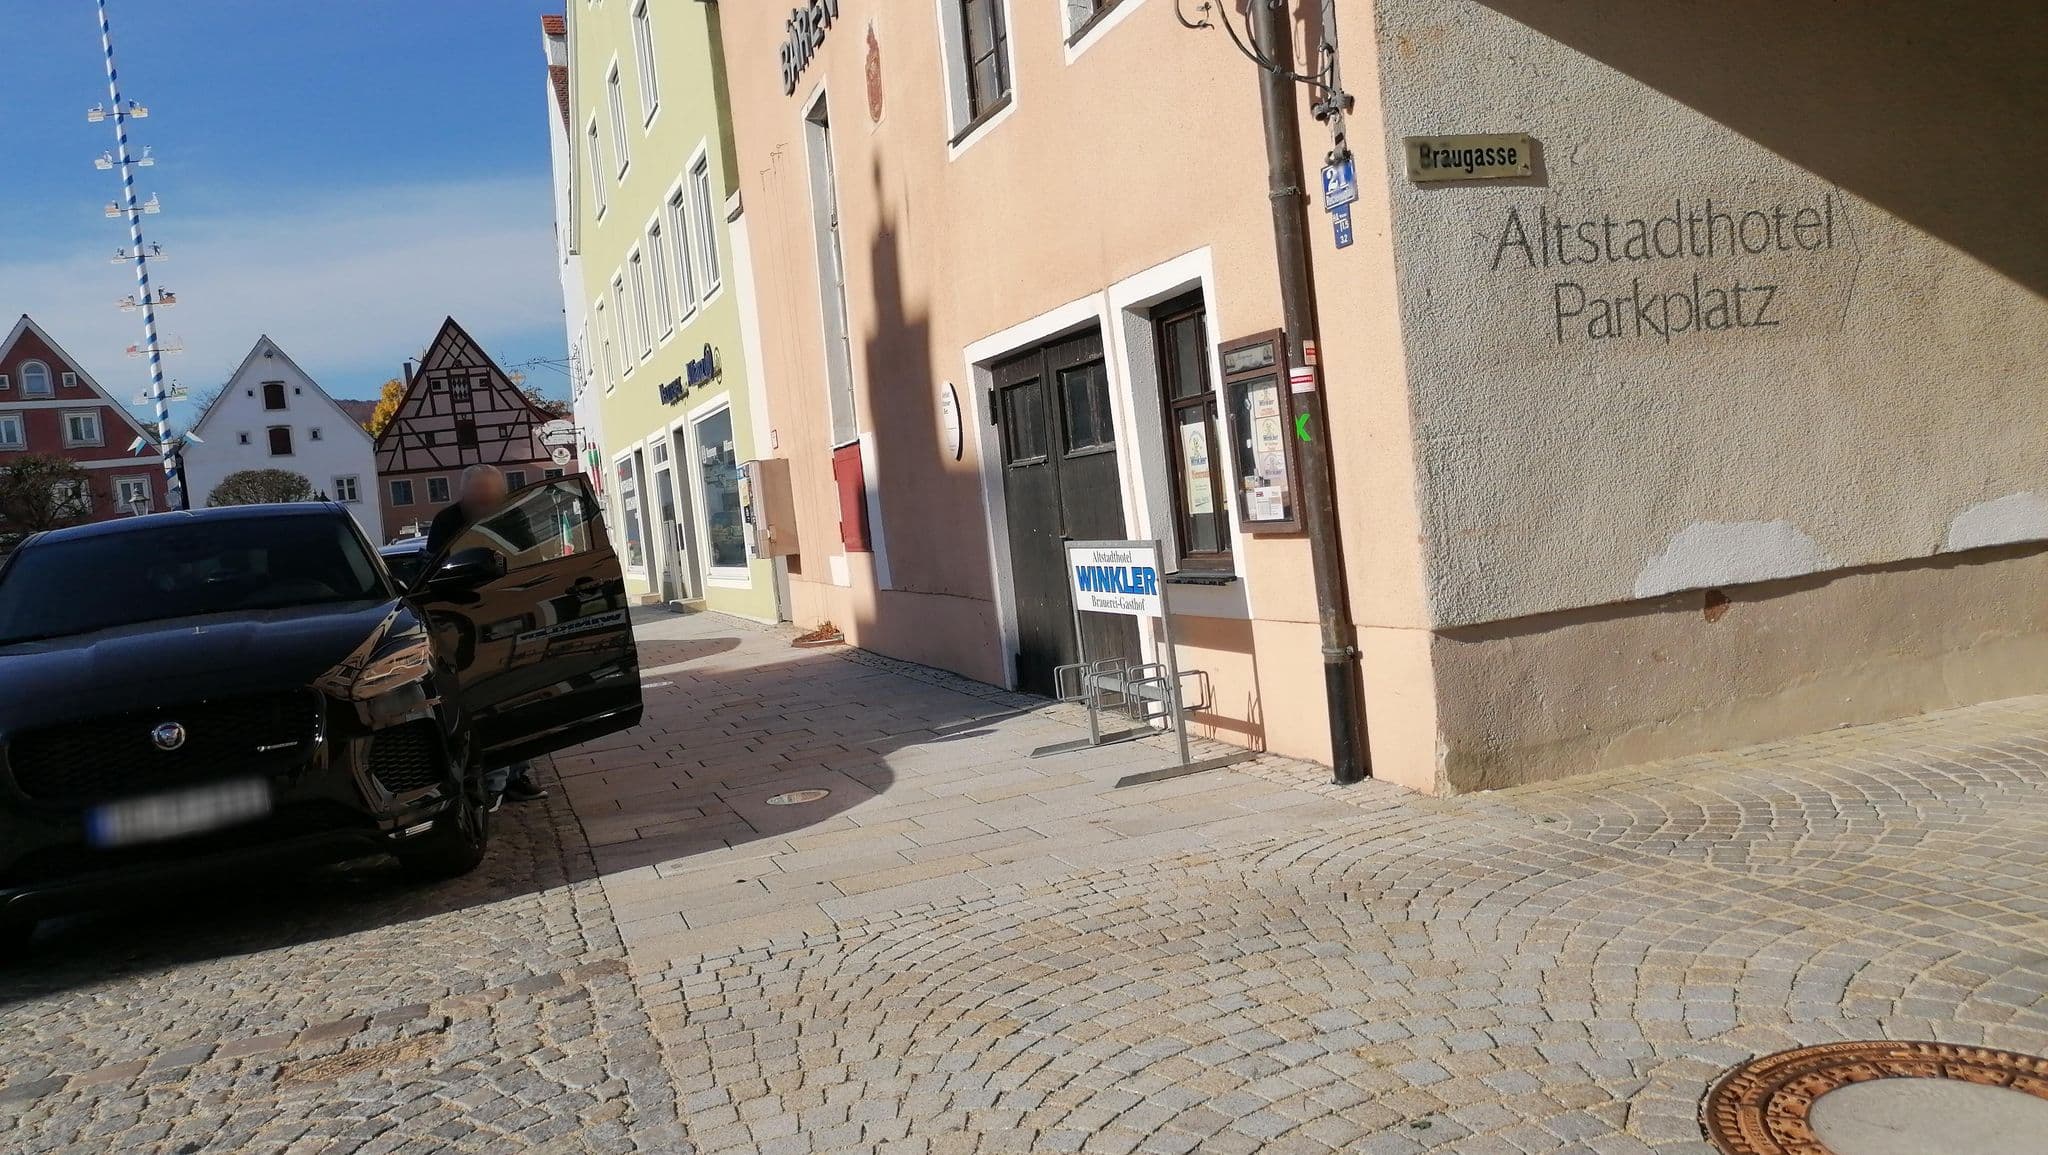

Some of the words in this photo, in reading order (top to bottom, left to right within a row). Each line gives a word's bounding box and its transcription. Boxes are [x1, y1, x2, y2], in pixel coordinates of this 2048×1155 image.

[1490, 193, 1834, 271] Altstadthotel
[1553, 272, 1780, 345] Parkplatz
[1093, 550, 1132, 563] Altstadthotel
[1075, 565, 1158, 596] WINKLER
[1091, 595, 1145, 611] Brauerei-Gasthof
